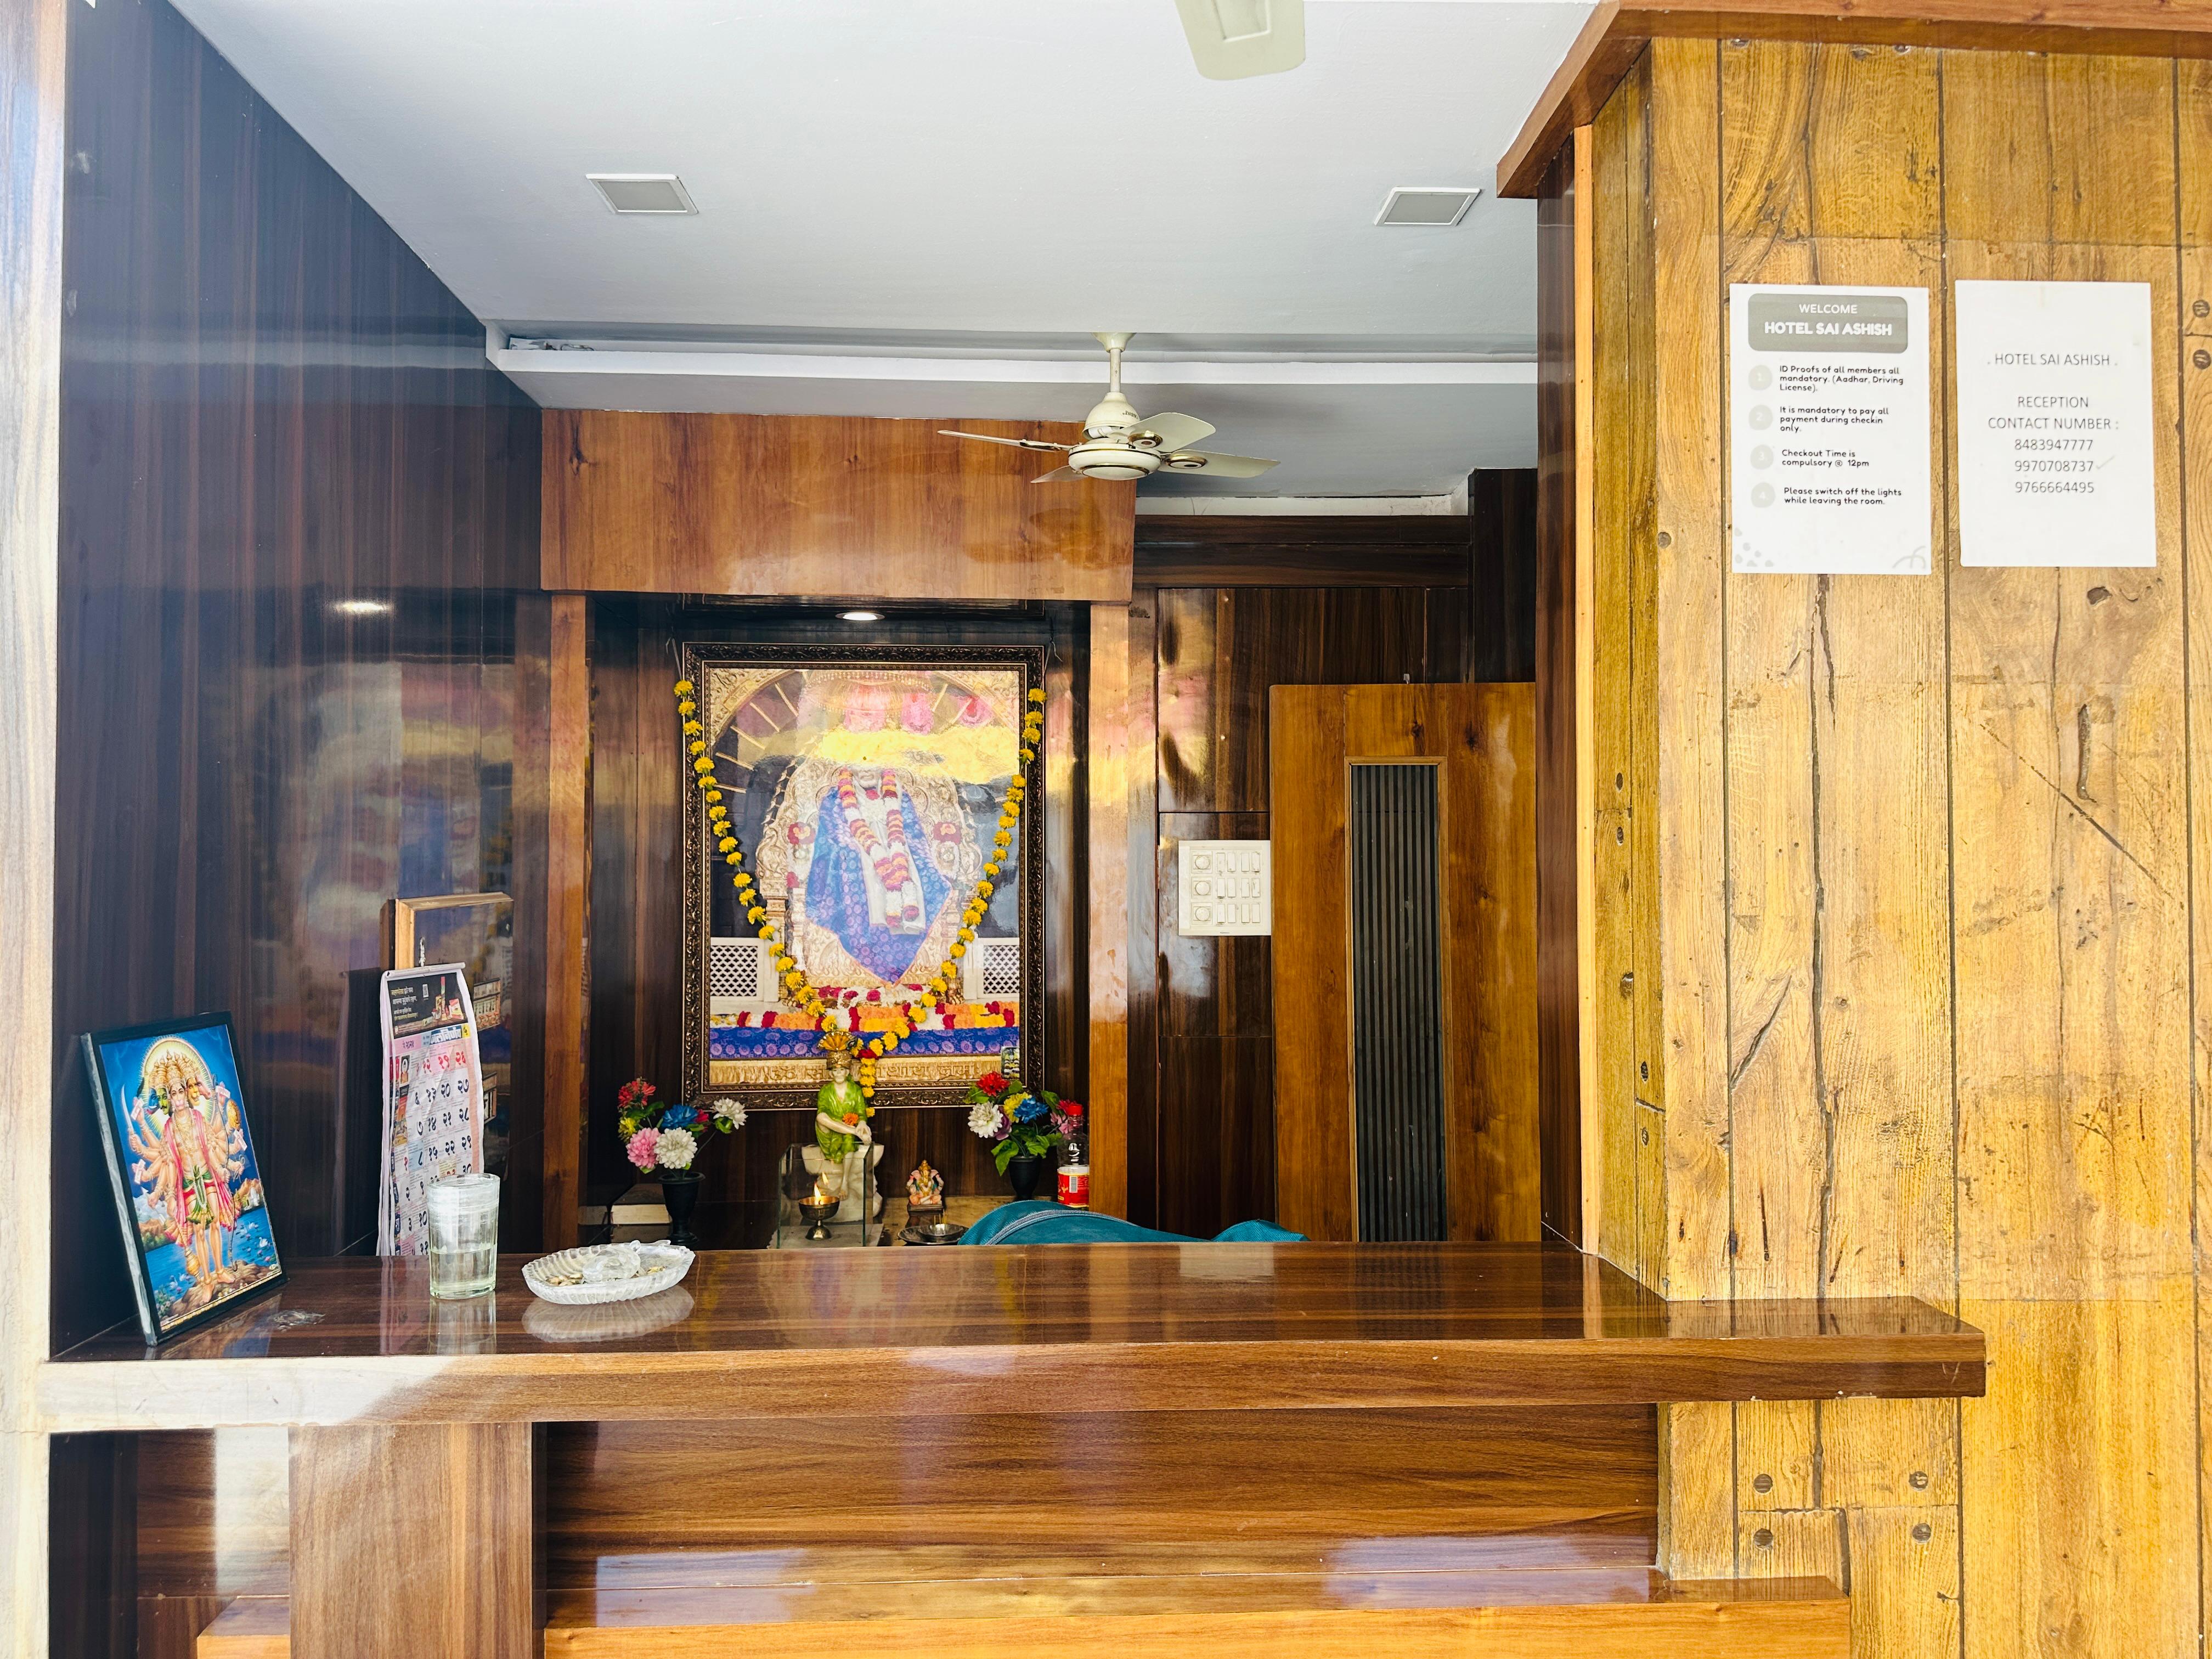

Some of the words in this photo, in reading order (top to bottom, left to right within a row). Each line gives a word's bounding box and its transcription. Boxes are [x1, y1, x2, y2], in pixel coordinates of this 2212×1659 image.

[1799, 304, 1858, 314] WELCOME
[1764, 321, 1813, 335] HOTEL
[1816, 323, 1839, 335] SAI
[1842, 323, 1892, 336] ASHISH
[1995, 353, 2036, 365] HOTEL
[2040, 354, 2060, 365] SAI
[2064, 354, 2110, 366] ASHISH
[1780, 375, 1830, 383] mandatory.
[1832, 375, 1870, 384] (Aadhar,
[1873, 376, 1903, 385] Driving
[1780, 384, 1818, 393] License).
[2018, 396, 2089, 408] RECEPTION
[1798, 407, 1845, 416] mandatory
[1860, 409, 1875, 417] pay
[1780, 415, 1818, 425] payment
[1821, 416, 1848, 425] during
[1988, 417, 2049, 429] CONTACT
[2055, 418, 2111, 430] NUMBER
[1780, 424, 1802, 433] only.
[2015, 439, 2093, 450] 8483947777
[1782, 459, 1832, 468] compulsory
[1848, 459, 1869, 468] 12pm
[2015, 460, 2093, 472] 9970708737
[1815, 487, 1843, 495] switch
[1846, 487, 1859, 495] off
[1877, 488, 1901, 497] lights
[2015, 482, 2094, 493] 9766664495
[1809, 497, 1841, 506] leaving
